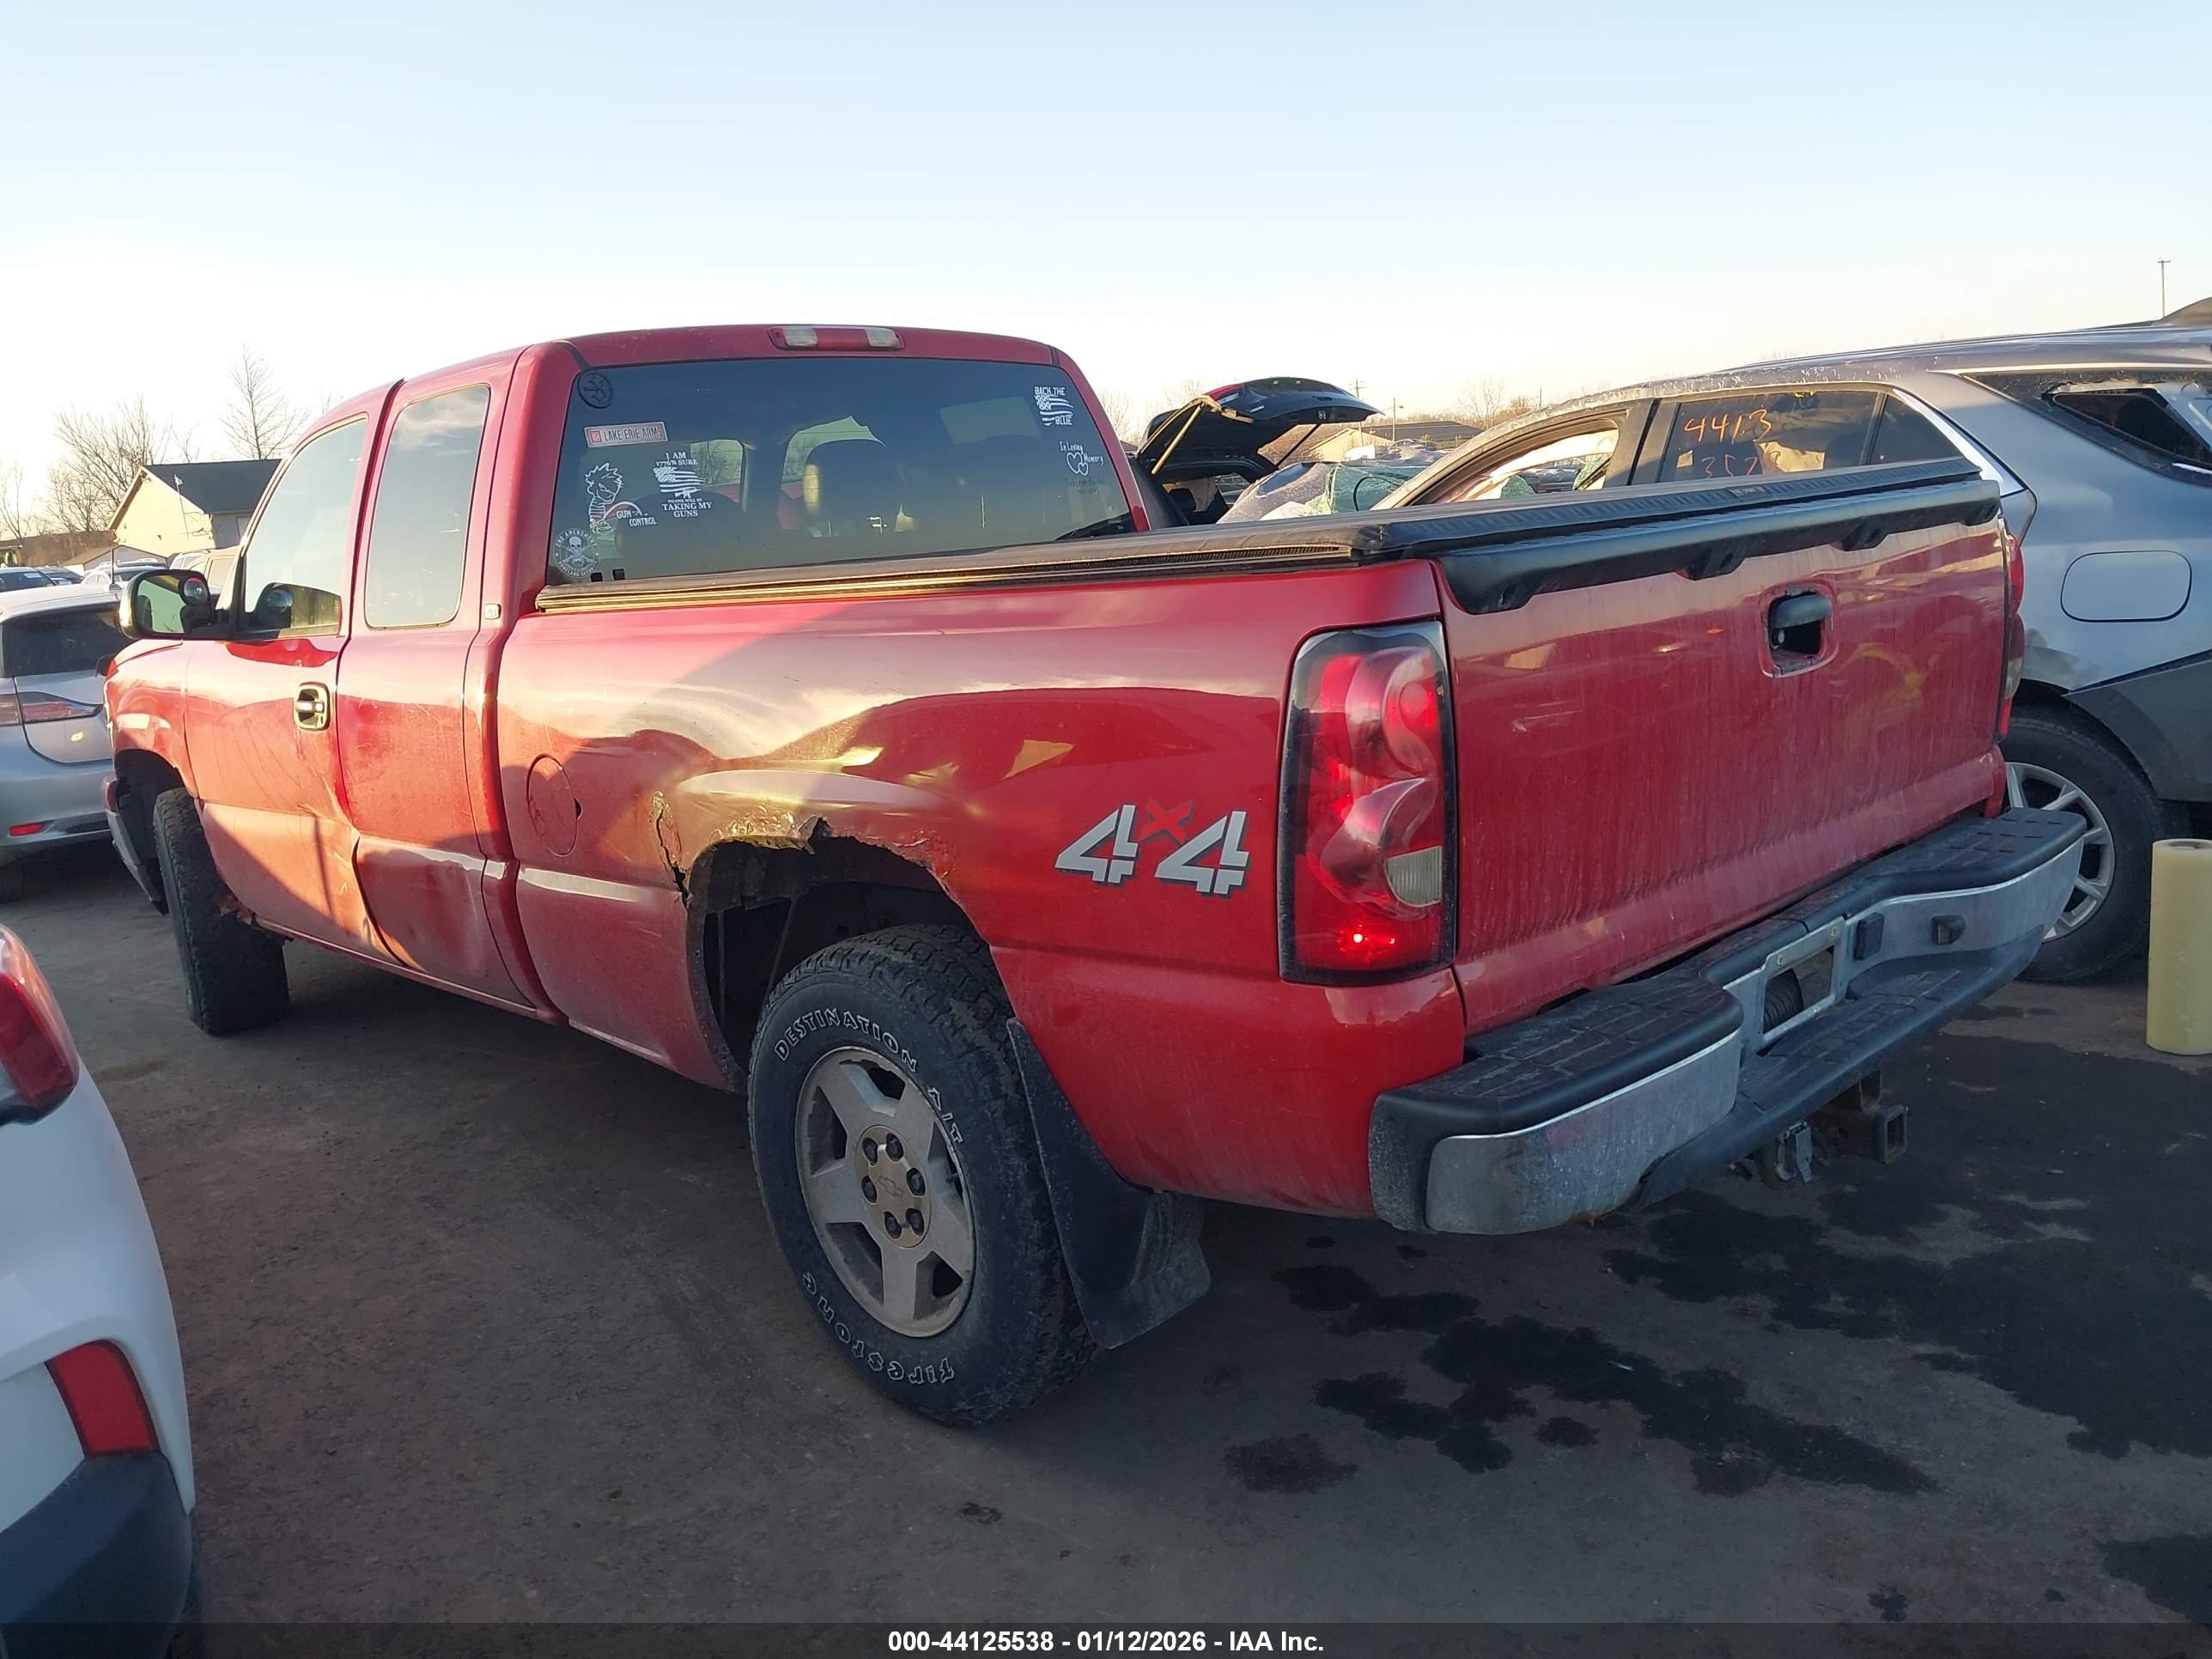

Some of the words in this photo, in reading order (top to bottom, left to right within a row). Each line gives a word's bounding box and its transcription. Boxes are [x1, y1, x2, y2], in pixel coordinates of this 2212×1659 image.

[1034, 386, 1052, 396] BACK
[1053, 386, 1066, 396] THE
[1055, 416, 1073, 425] BLUE
[1684, 409, 1772, 444] 4413
[604, 429, 623, 441] LAKE
[624, 428, 640, 440] ERIE
[641, 427, 663, 439] ARMS
[1066, 441, 1084, 455] Loving
[656, 459, 677, 468] 1776%
[1084, 453, 1104, 465] Memory
[662, 502, 697, 511] TAKING
[616, 510, 632, 520] GUN
[673, 509, 699, 518] GUNS
[629, 516, 658, 527] CONTROL
[775, 1007, 918, 1073] DESTINATION
